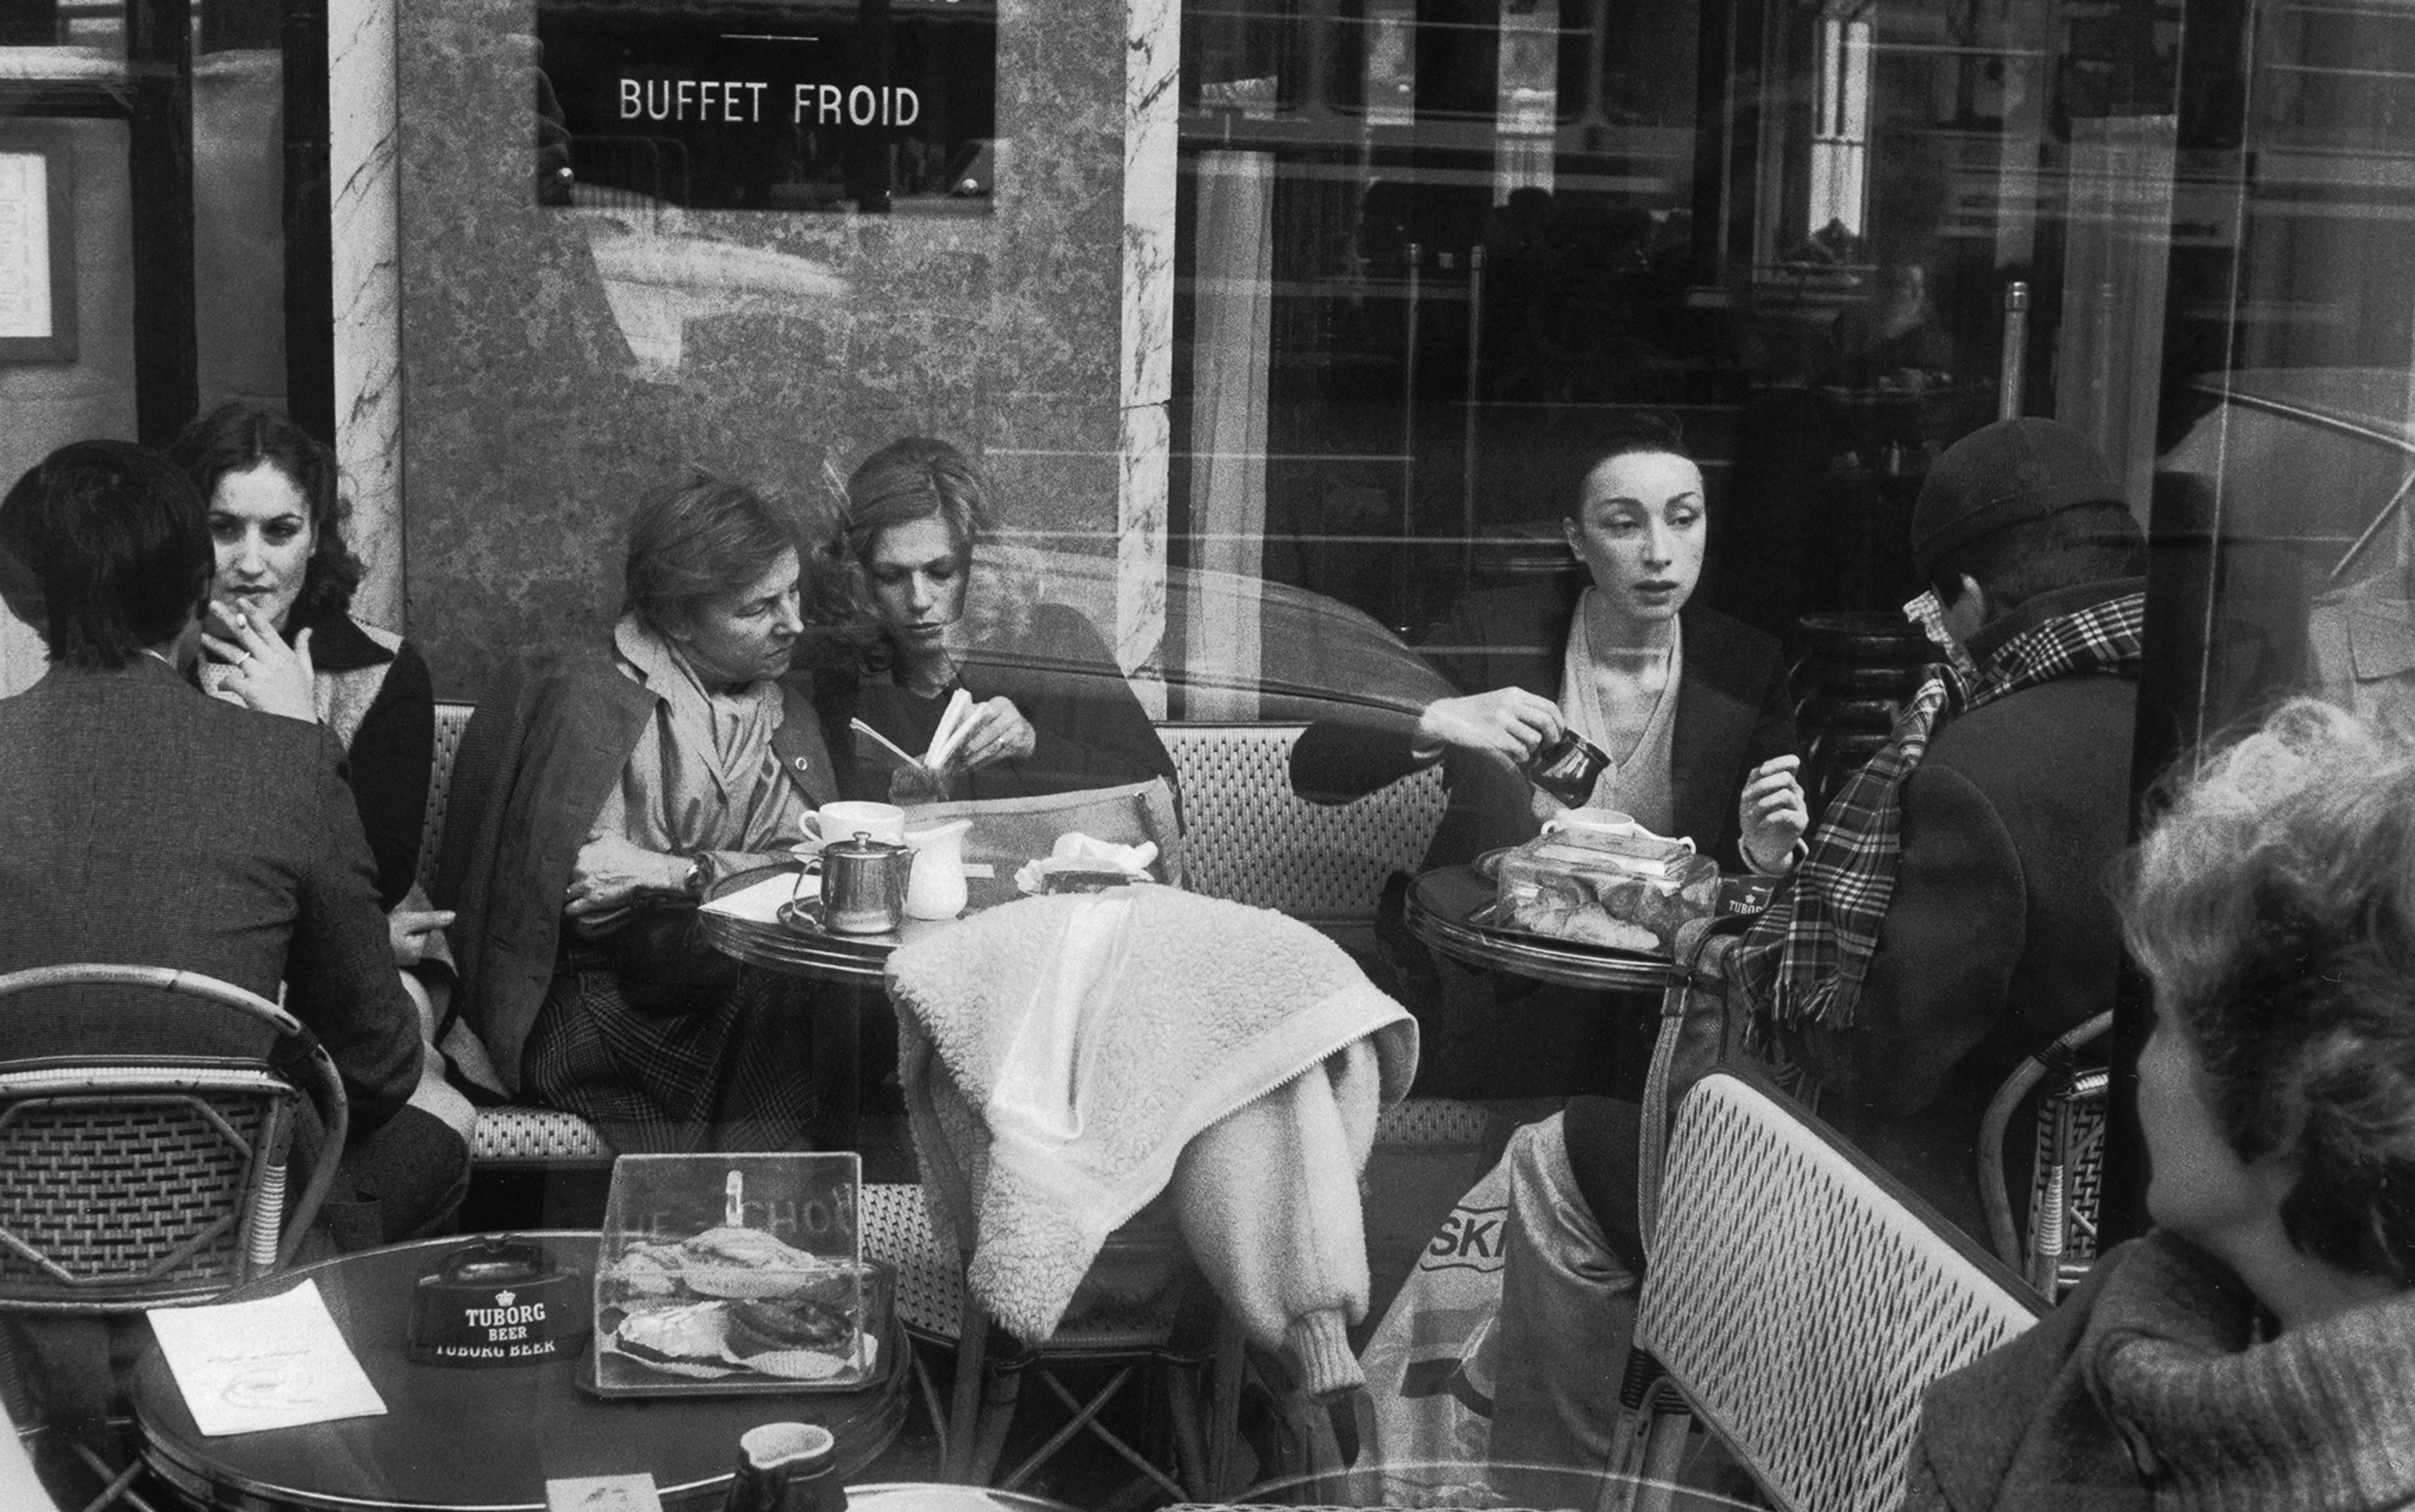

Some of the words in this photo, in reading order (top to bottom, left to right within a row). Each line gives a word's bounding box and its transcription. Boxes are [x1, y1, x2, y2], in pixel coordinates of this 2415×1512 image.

[620, 79, 767, 122] BUFFET
[795, 84, 919, 126] FROID
[465, 1303, 546, 1326] TUBORG
[489, 1326, 527, 1342] BEER
